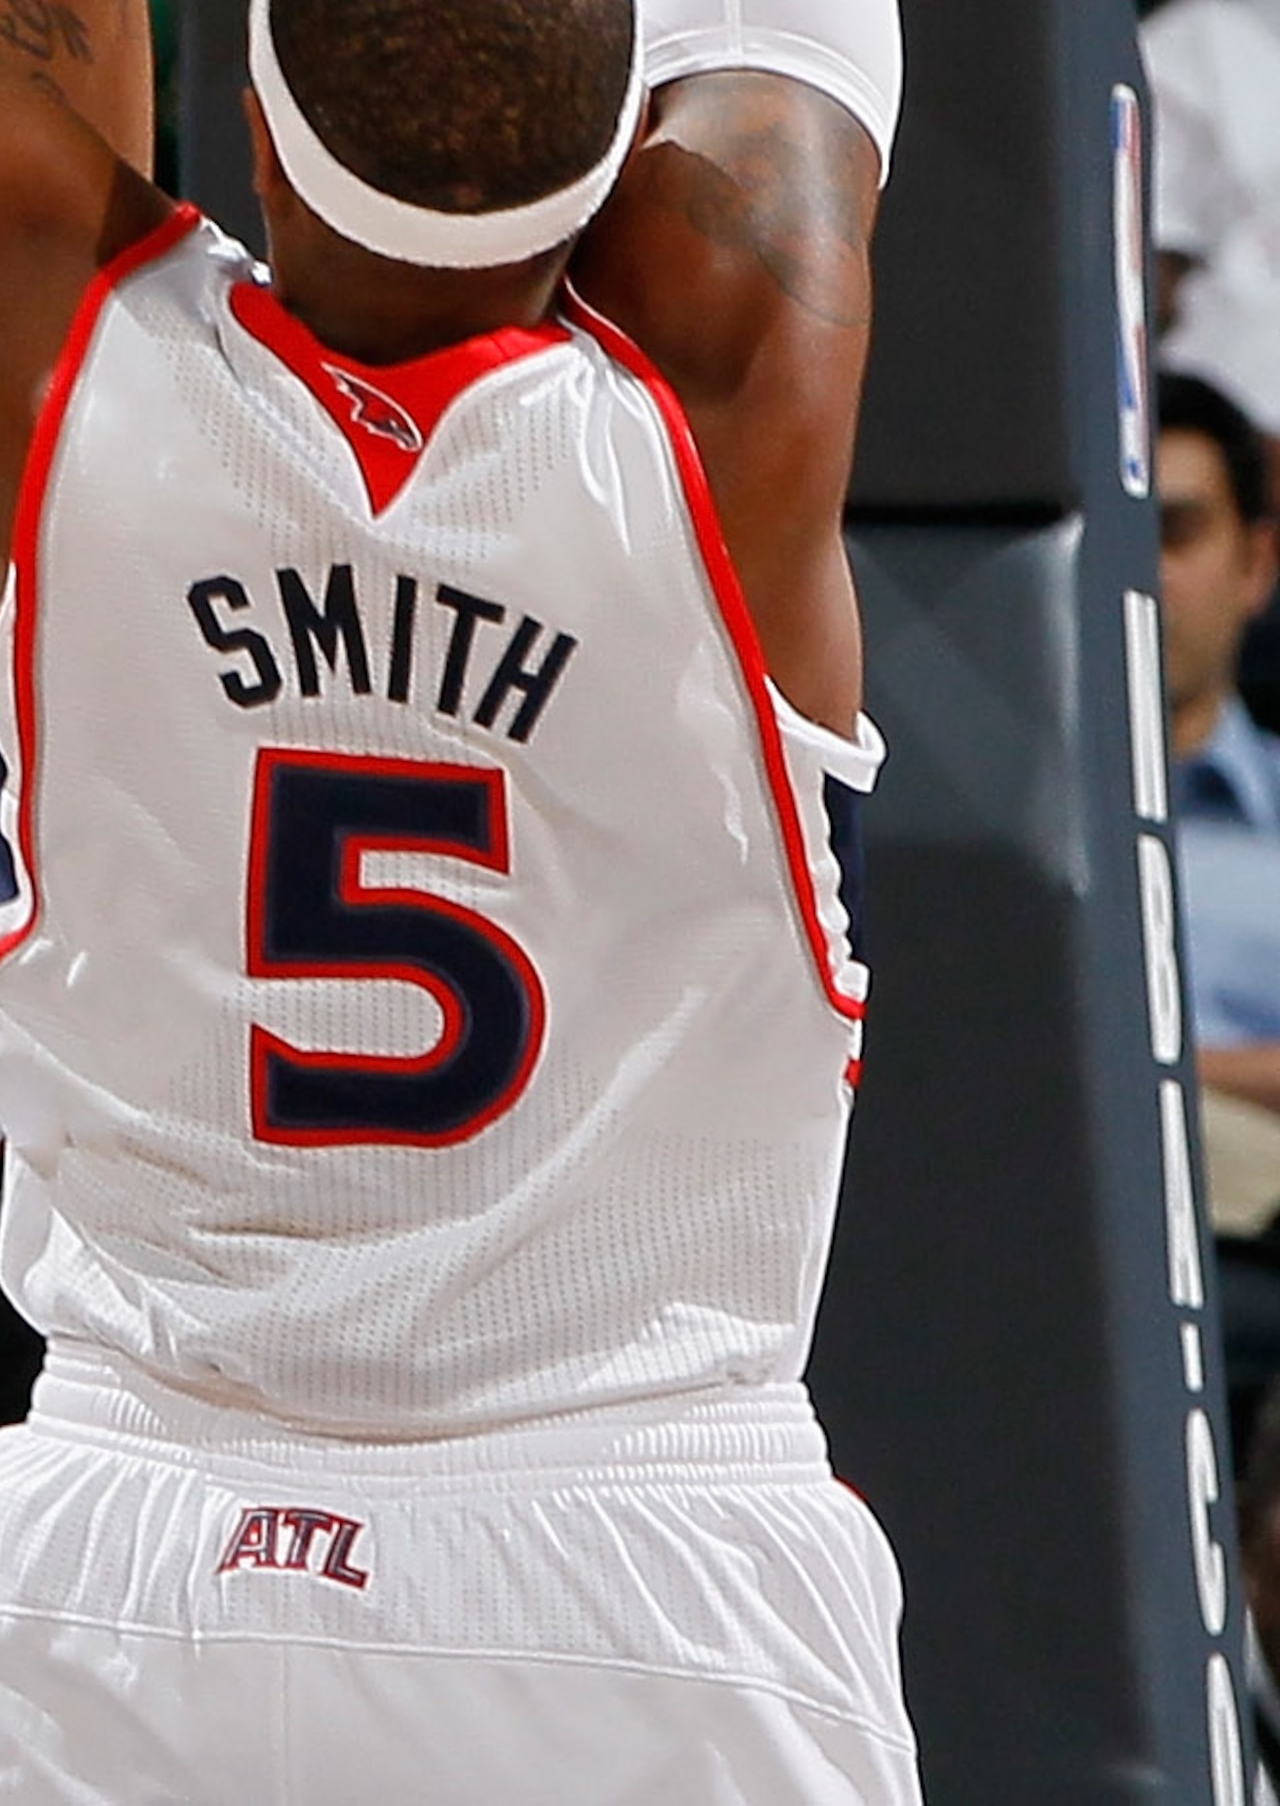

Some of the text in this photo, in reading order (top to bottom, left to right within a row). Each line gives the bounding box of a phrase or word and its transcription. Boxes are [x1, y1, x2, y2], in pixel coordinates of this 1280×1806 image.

[186, 562, 579, 744] SMITH
[245, 746, 548, 1151] 5
[213, 1504, 372, 1591] ATL
